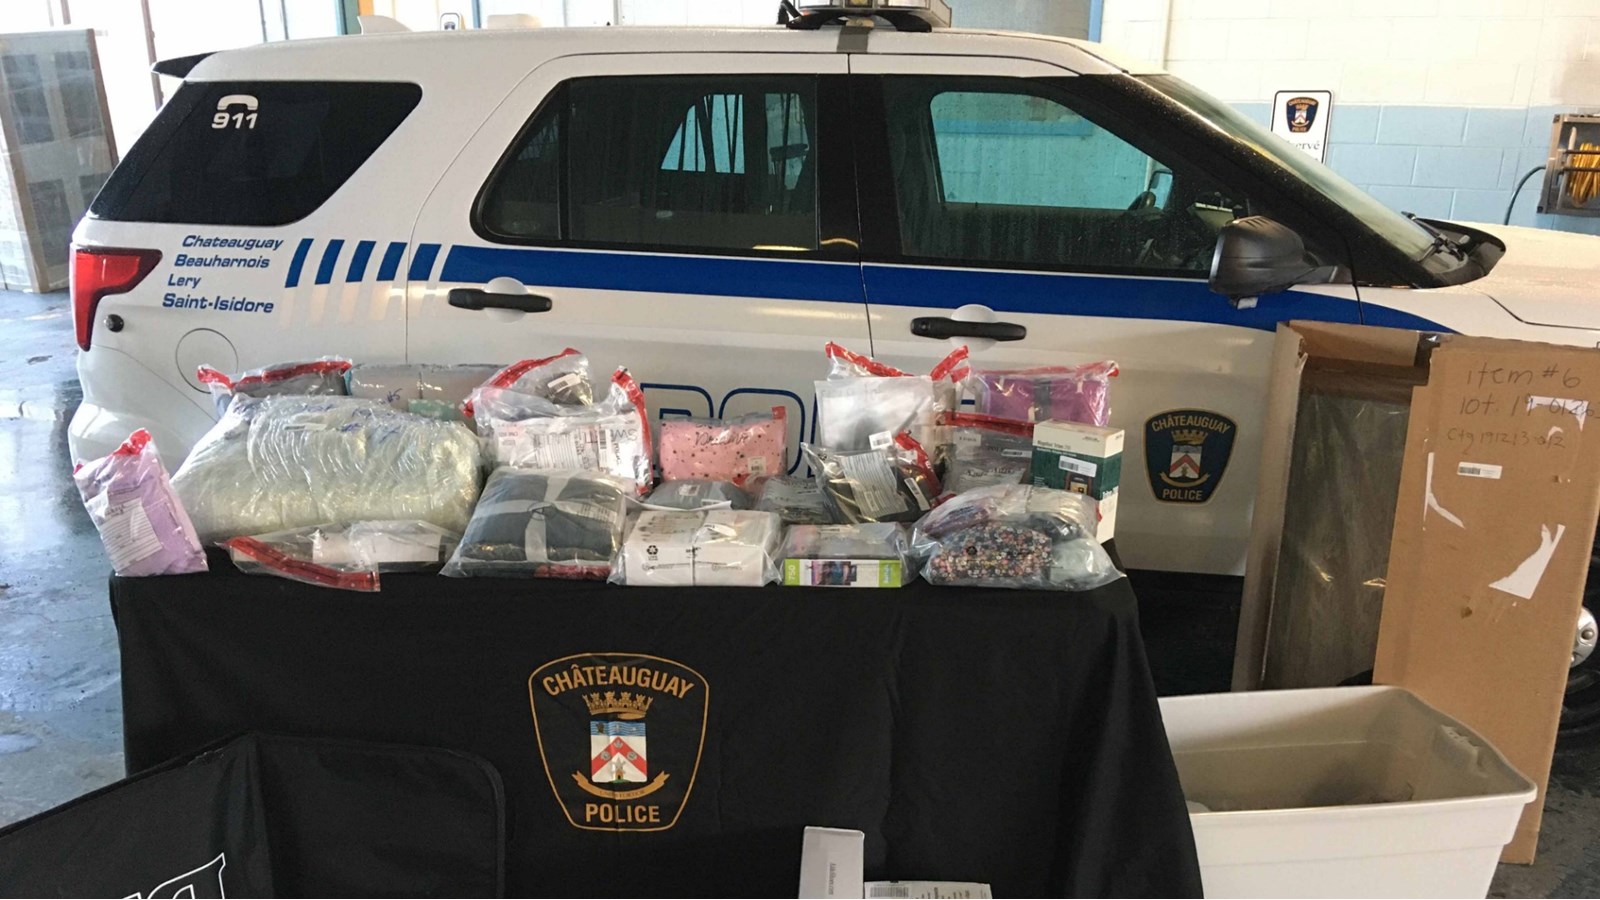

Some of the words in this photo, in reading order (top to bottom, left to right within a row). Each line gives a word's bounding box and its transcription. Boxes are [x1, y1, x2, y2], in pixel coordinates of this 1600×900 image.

[211, 112, 258, 129] 911
[182, 235, 284, 251] Chateauguay
[174, 253, 271, 268] Beauharnois
[167, 273, 202, 289] Lery
[162, 292, 275, 313] Saint-Isidore
[1466, 362, 1534, 389] item
[1151, 414, 1231, 434] CHÂTEAUGUAY
[1162, 489, 1203, 501] POLICE
[542, 664, 695, 699] CHÂTEAUGUAY
[585, 803, 661, 823] POLICE
